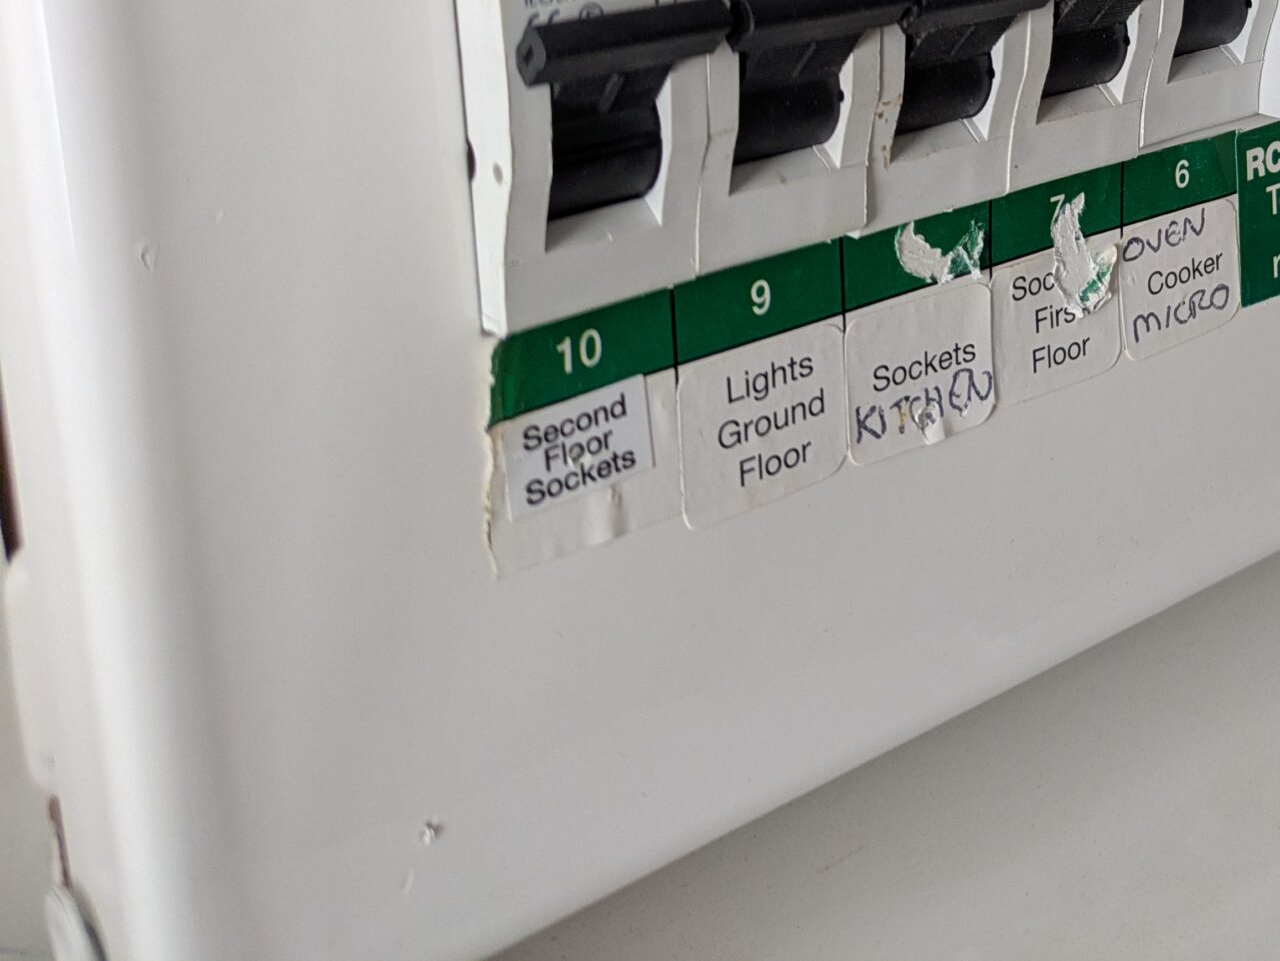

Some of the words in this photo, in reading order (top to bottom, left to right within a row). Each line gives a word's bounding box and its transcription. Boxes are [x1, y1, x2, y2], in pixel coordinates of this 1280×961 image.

[1174, 158, 1191, 189] 6
[1121, 207, 1206, 263] OVEN
[749, 278, 772, 317] 9
[1147, 252, 1224, 295] Cooker
[1033, 302, 1091, 335] Firs
[1132, 283, 1231, 344] MICRO
[555, 328, 603, 375] 10
[872, 341, 977, 393] Sockets
[1031, 336, 1091, 373] Floor
[726, 354, 815, 405] Lights
[521, 391, 630, 452] Second
[716, 386, 827, 451] Ground
[854, 367, 994, 445] KITCHEN
[543, 428, 615, 474] Floor
[738, 439, 813, 489] Floor
[525, 447, 638, 507] Sockets
